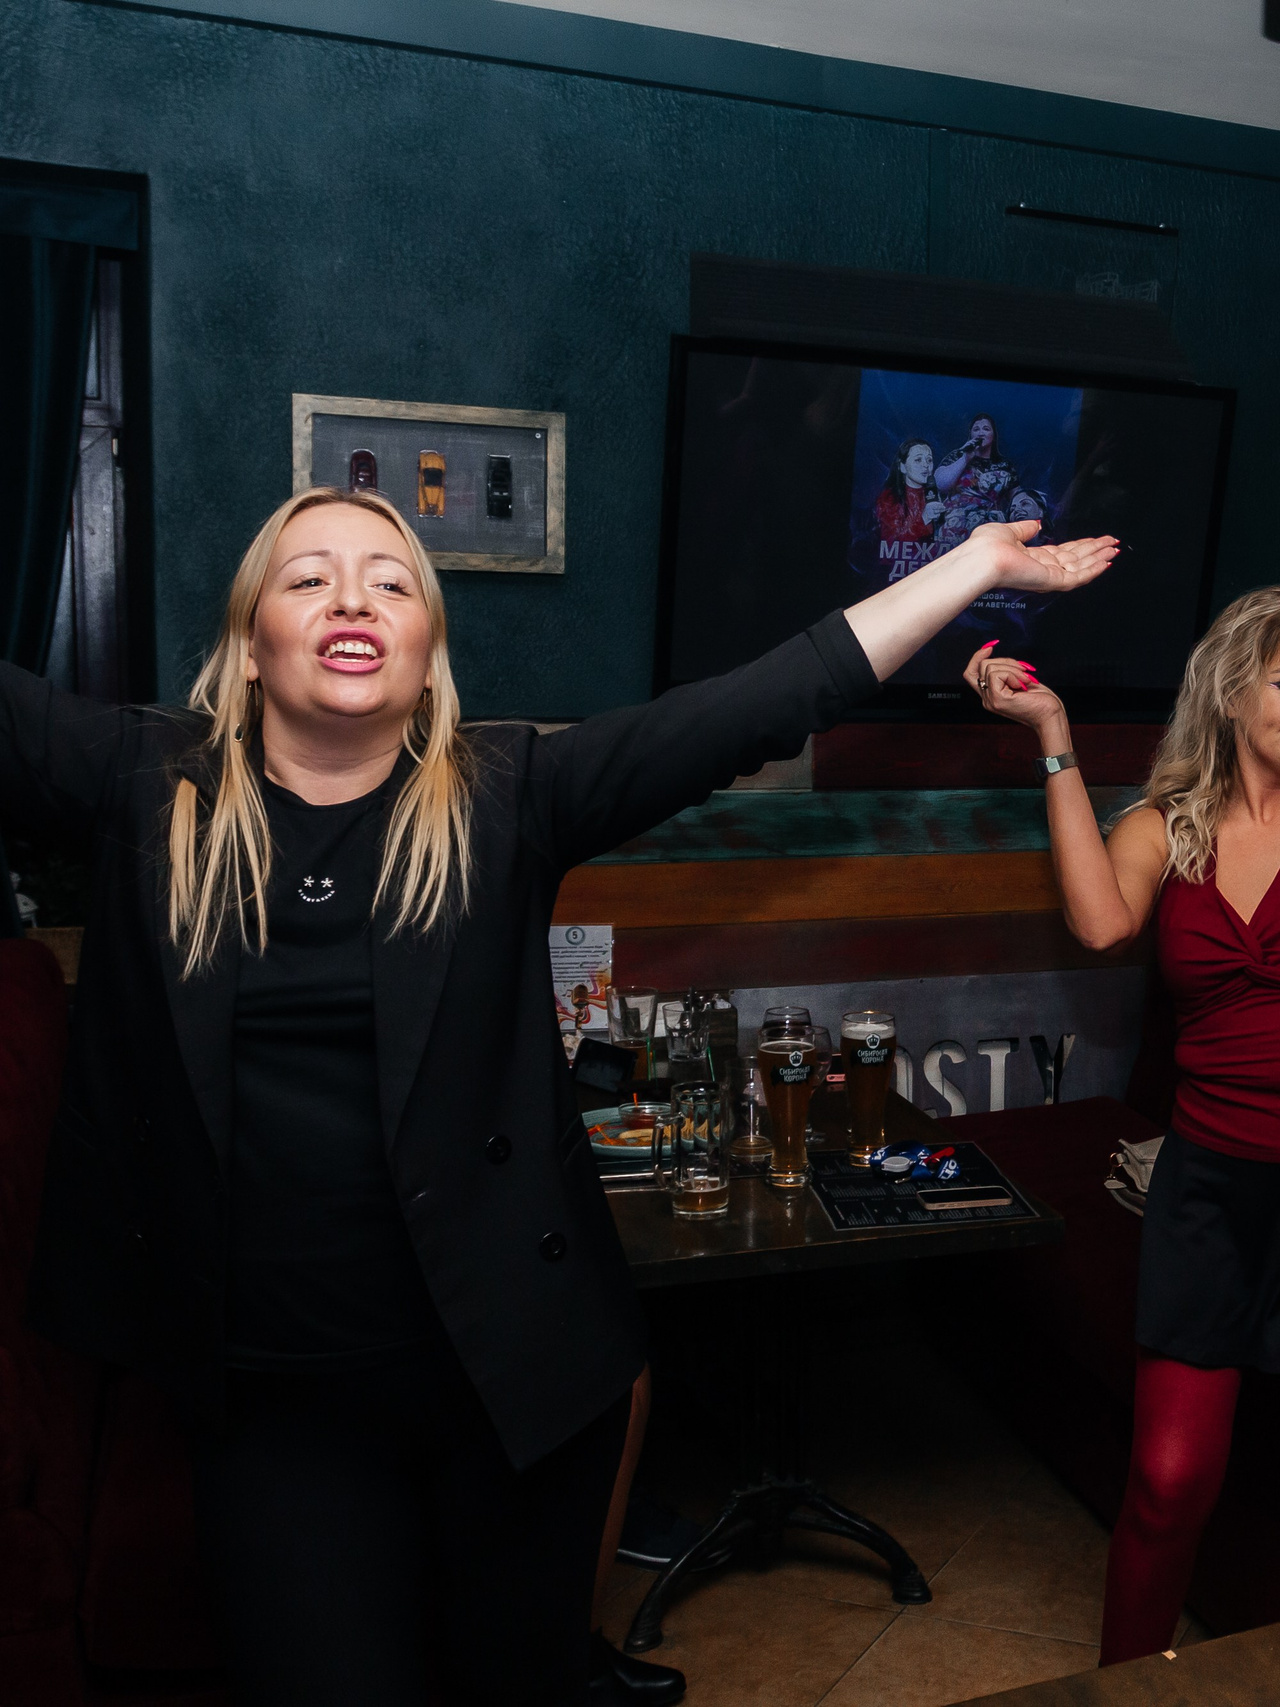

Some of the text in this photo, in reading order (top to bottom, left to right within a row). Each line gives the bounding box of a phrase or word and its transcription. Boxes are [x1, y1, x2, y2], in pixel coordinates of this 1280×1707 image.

[889, 560, 930, 582] ДЕ
[979, 593, 1005, 601] ШОВА
[985, 601, 1028, 610] АВЕТИСЯН
[927, 692, 962, 700] SAMSUNG
